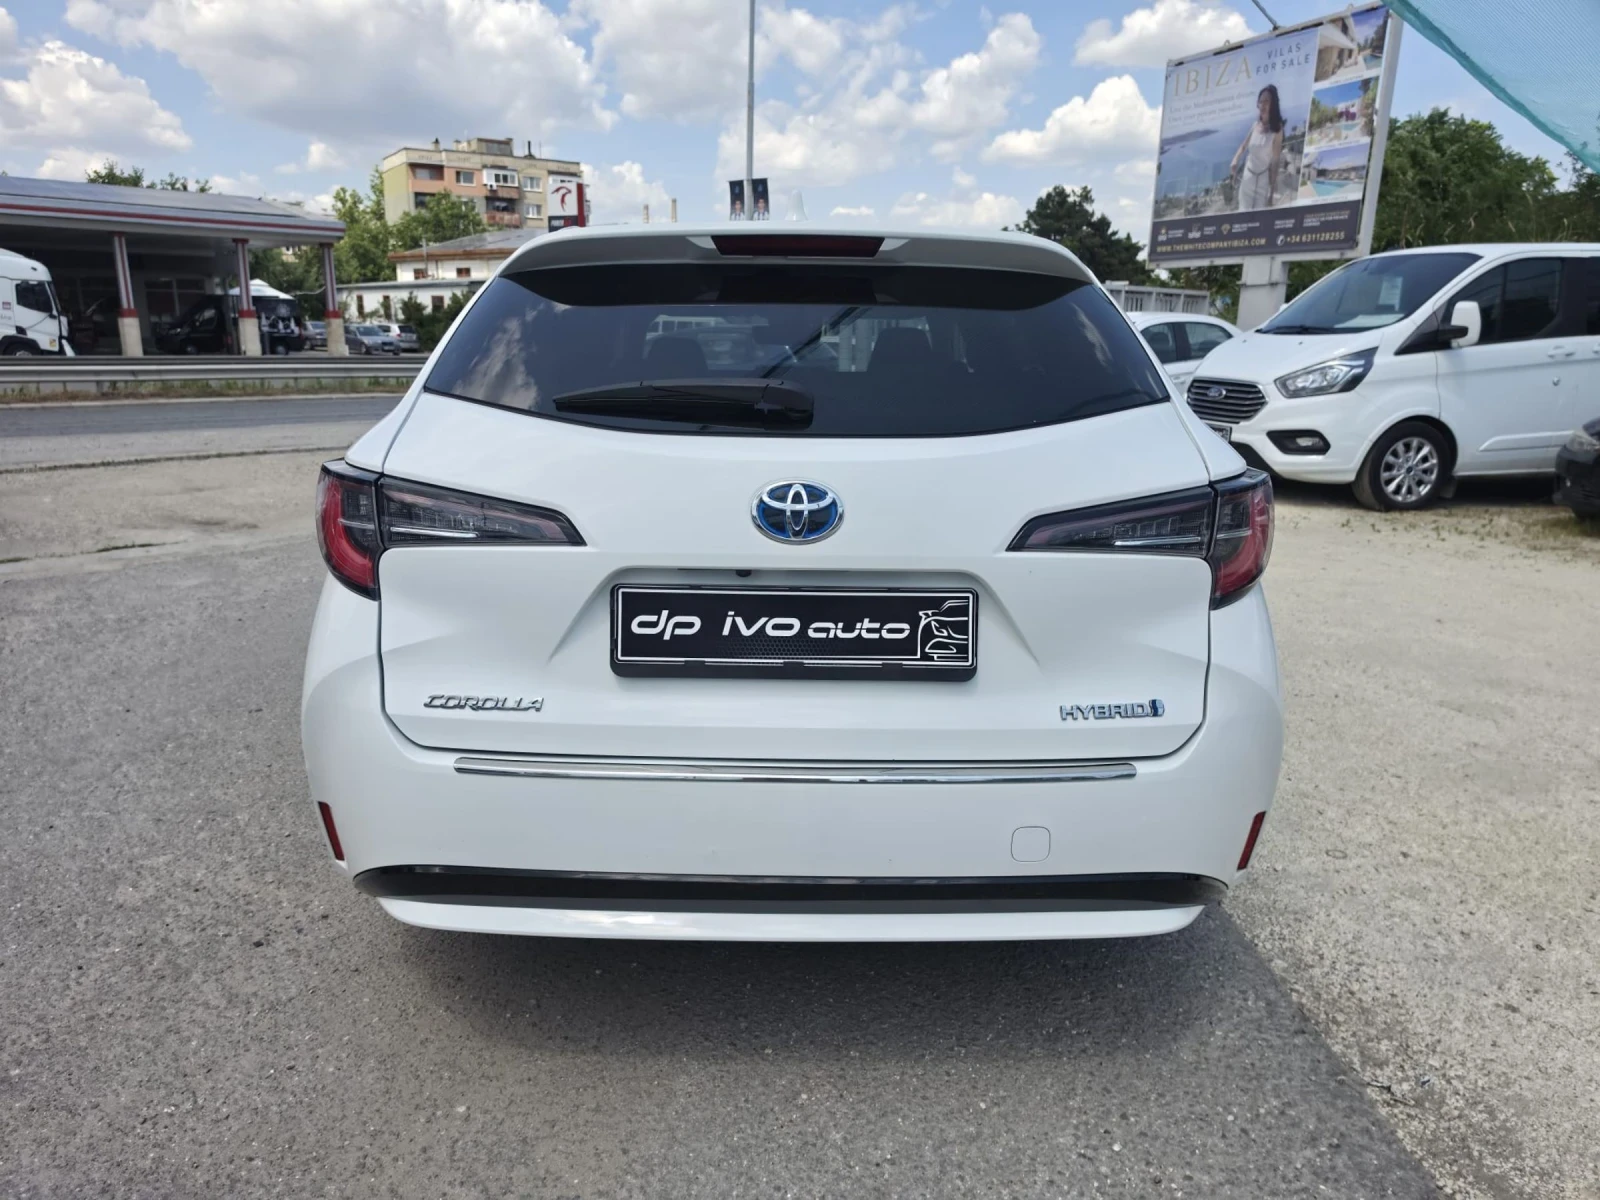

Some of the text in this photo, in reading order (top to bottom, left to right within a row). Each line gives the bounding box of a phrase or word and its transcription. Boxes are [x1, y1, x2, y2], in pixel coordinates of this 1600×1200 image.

[1267, 42, 1302, 60] VILAS
[1255, 53, 1312, 77] FOR SALE
[1174, 56, 1253, 97] IBIZA
[630, 609, 911, 641] dp ivo auto
[423, 694, 545, 712] COROLLA
[1060, 702, 1150, 721] HYBRID
